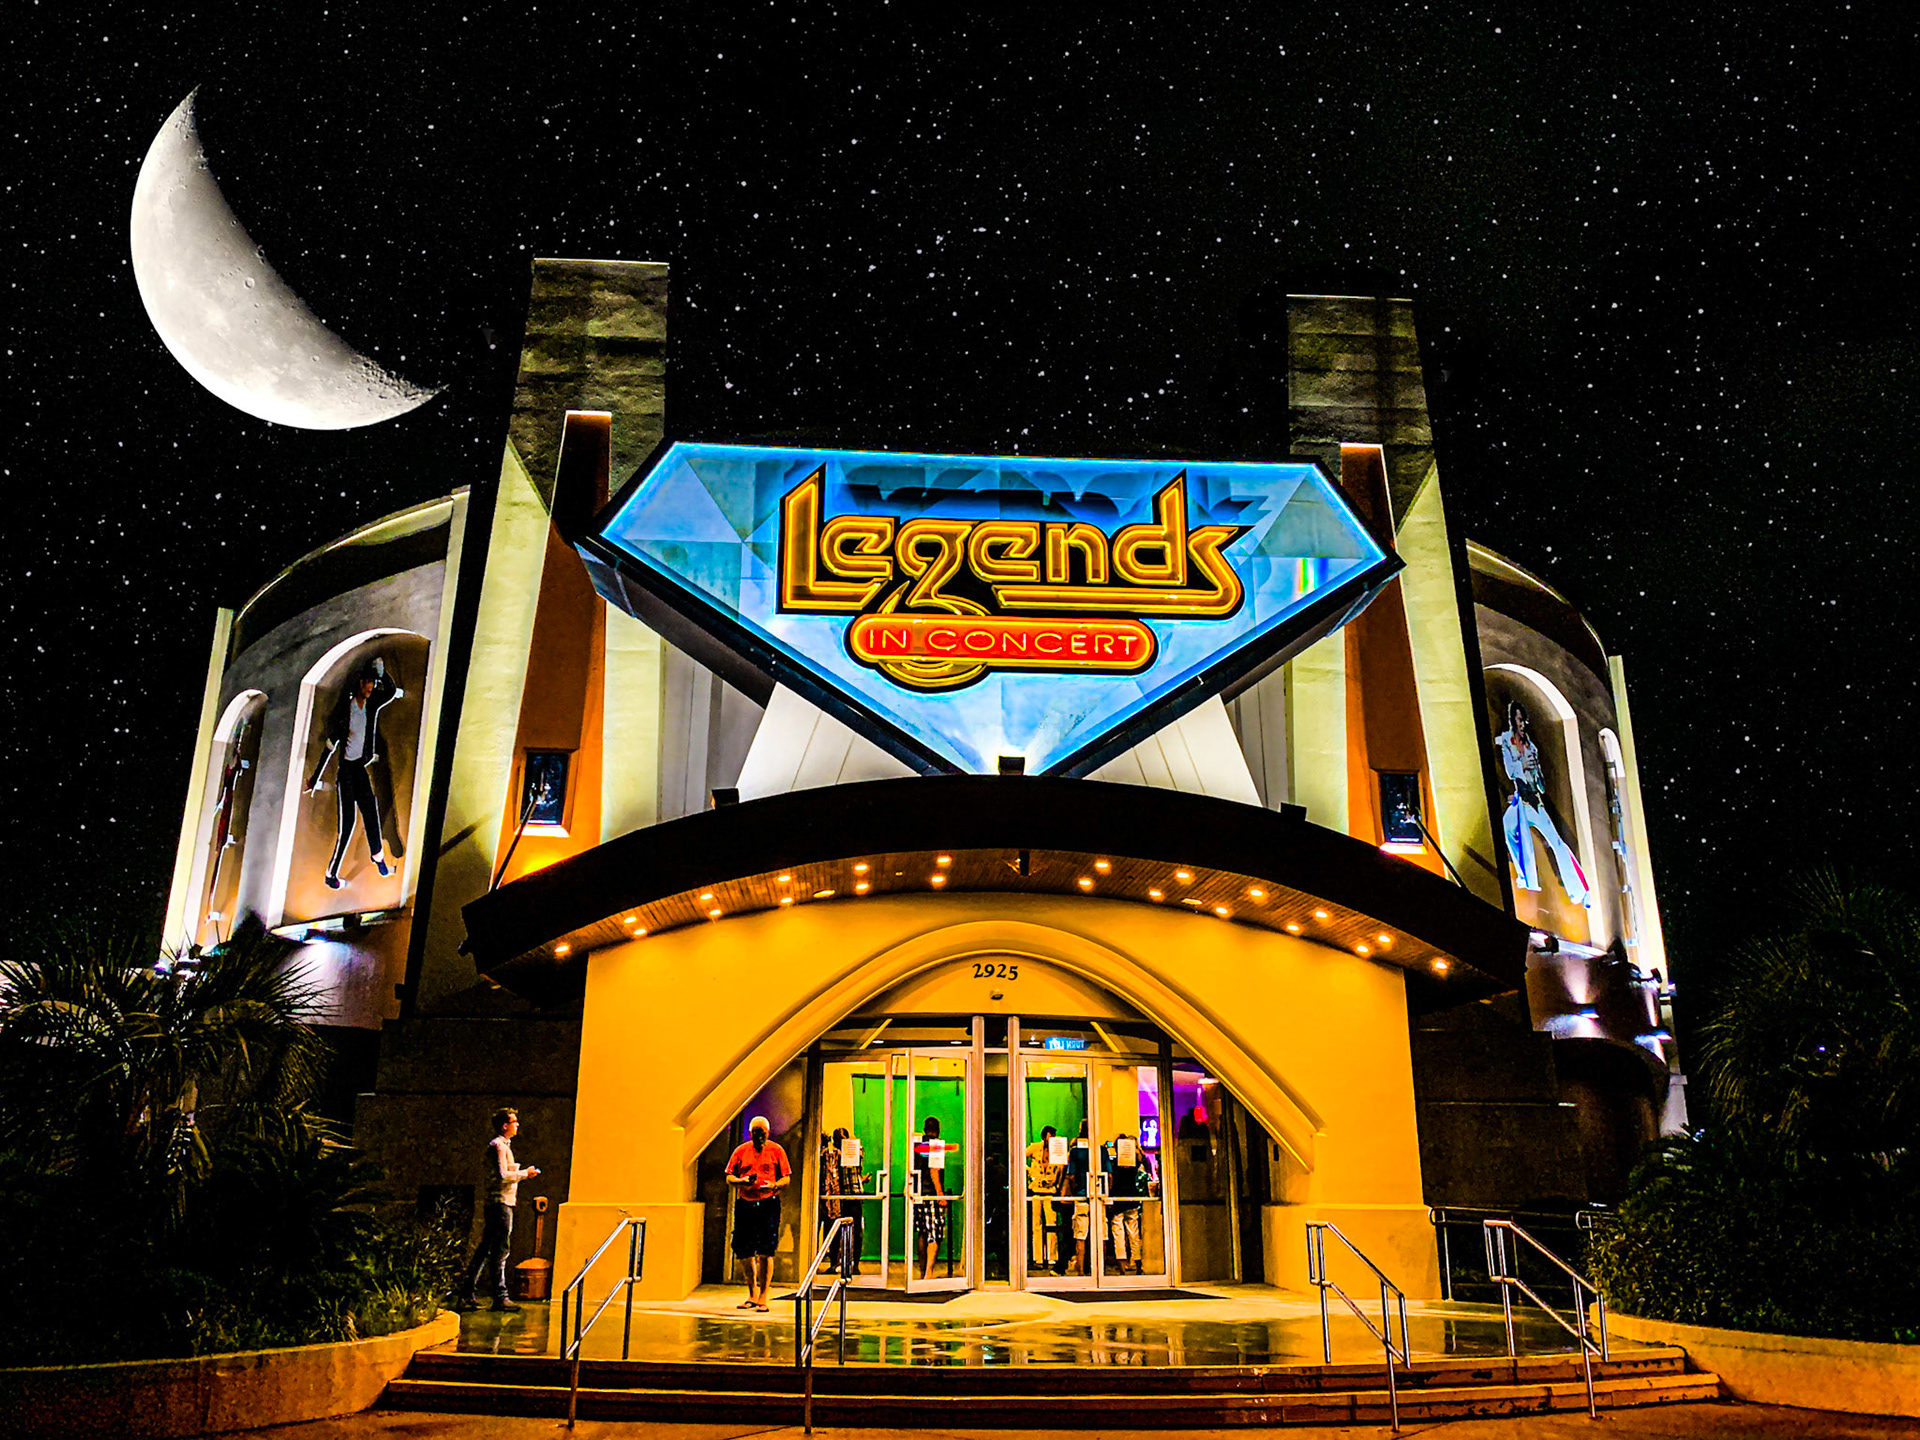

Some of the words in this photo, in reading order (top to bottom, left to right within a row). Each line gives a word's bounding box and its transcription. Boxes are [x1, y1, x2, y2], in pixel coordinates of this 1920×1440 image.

[779, 465, 1242, 686] Legends
[866, 629, 907, 649] IN
[928, 629, 1138, 655] CONCERT
[972, 963, 1018, 981] 2925
